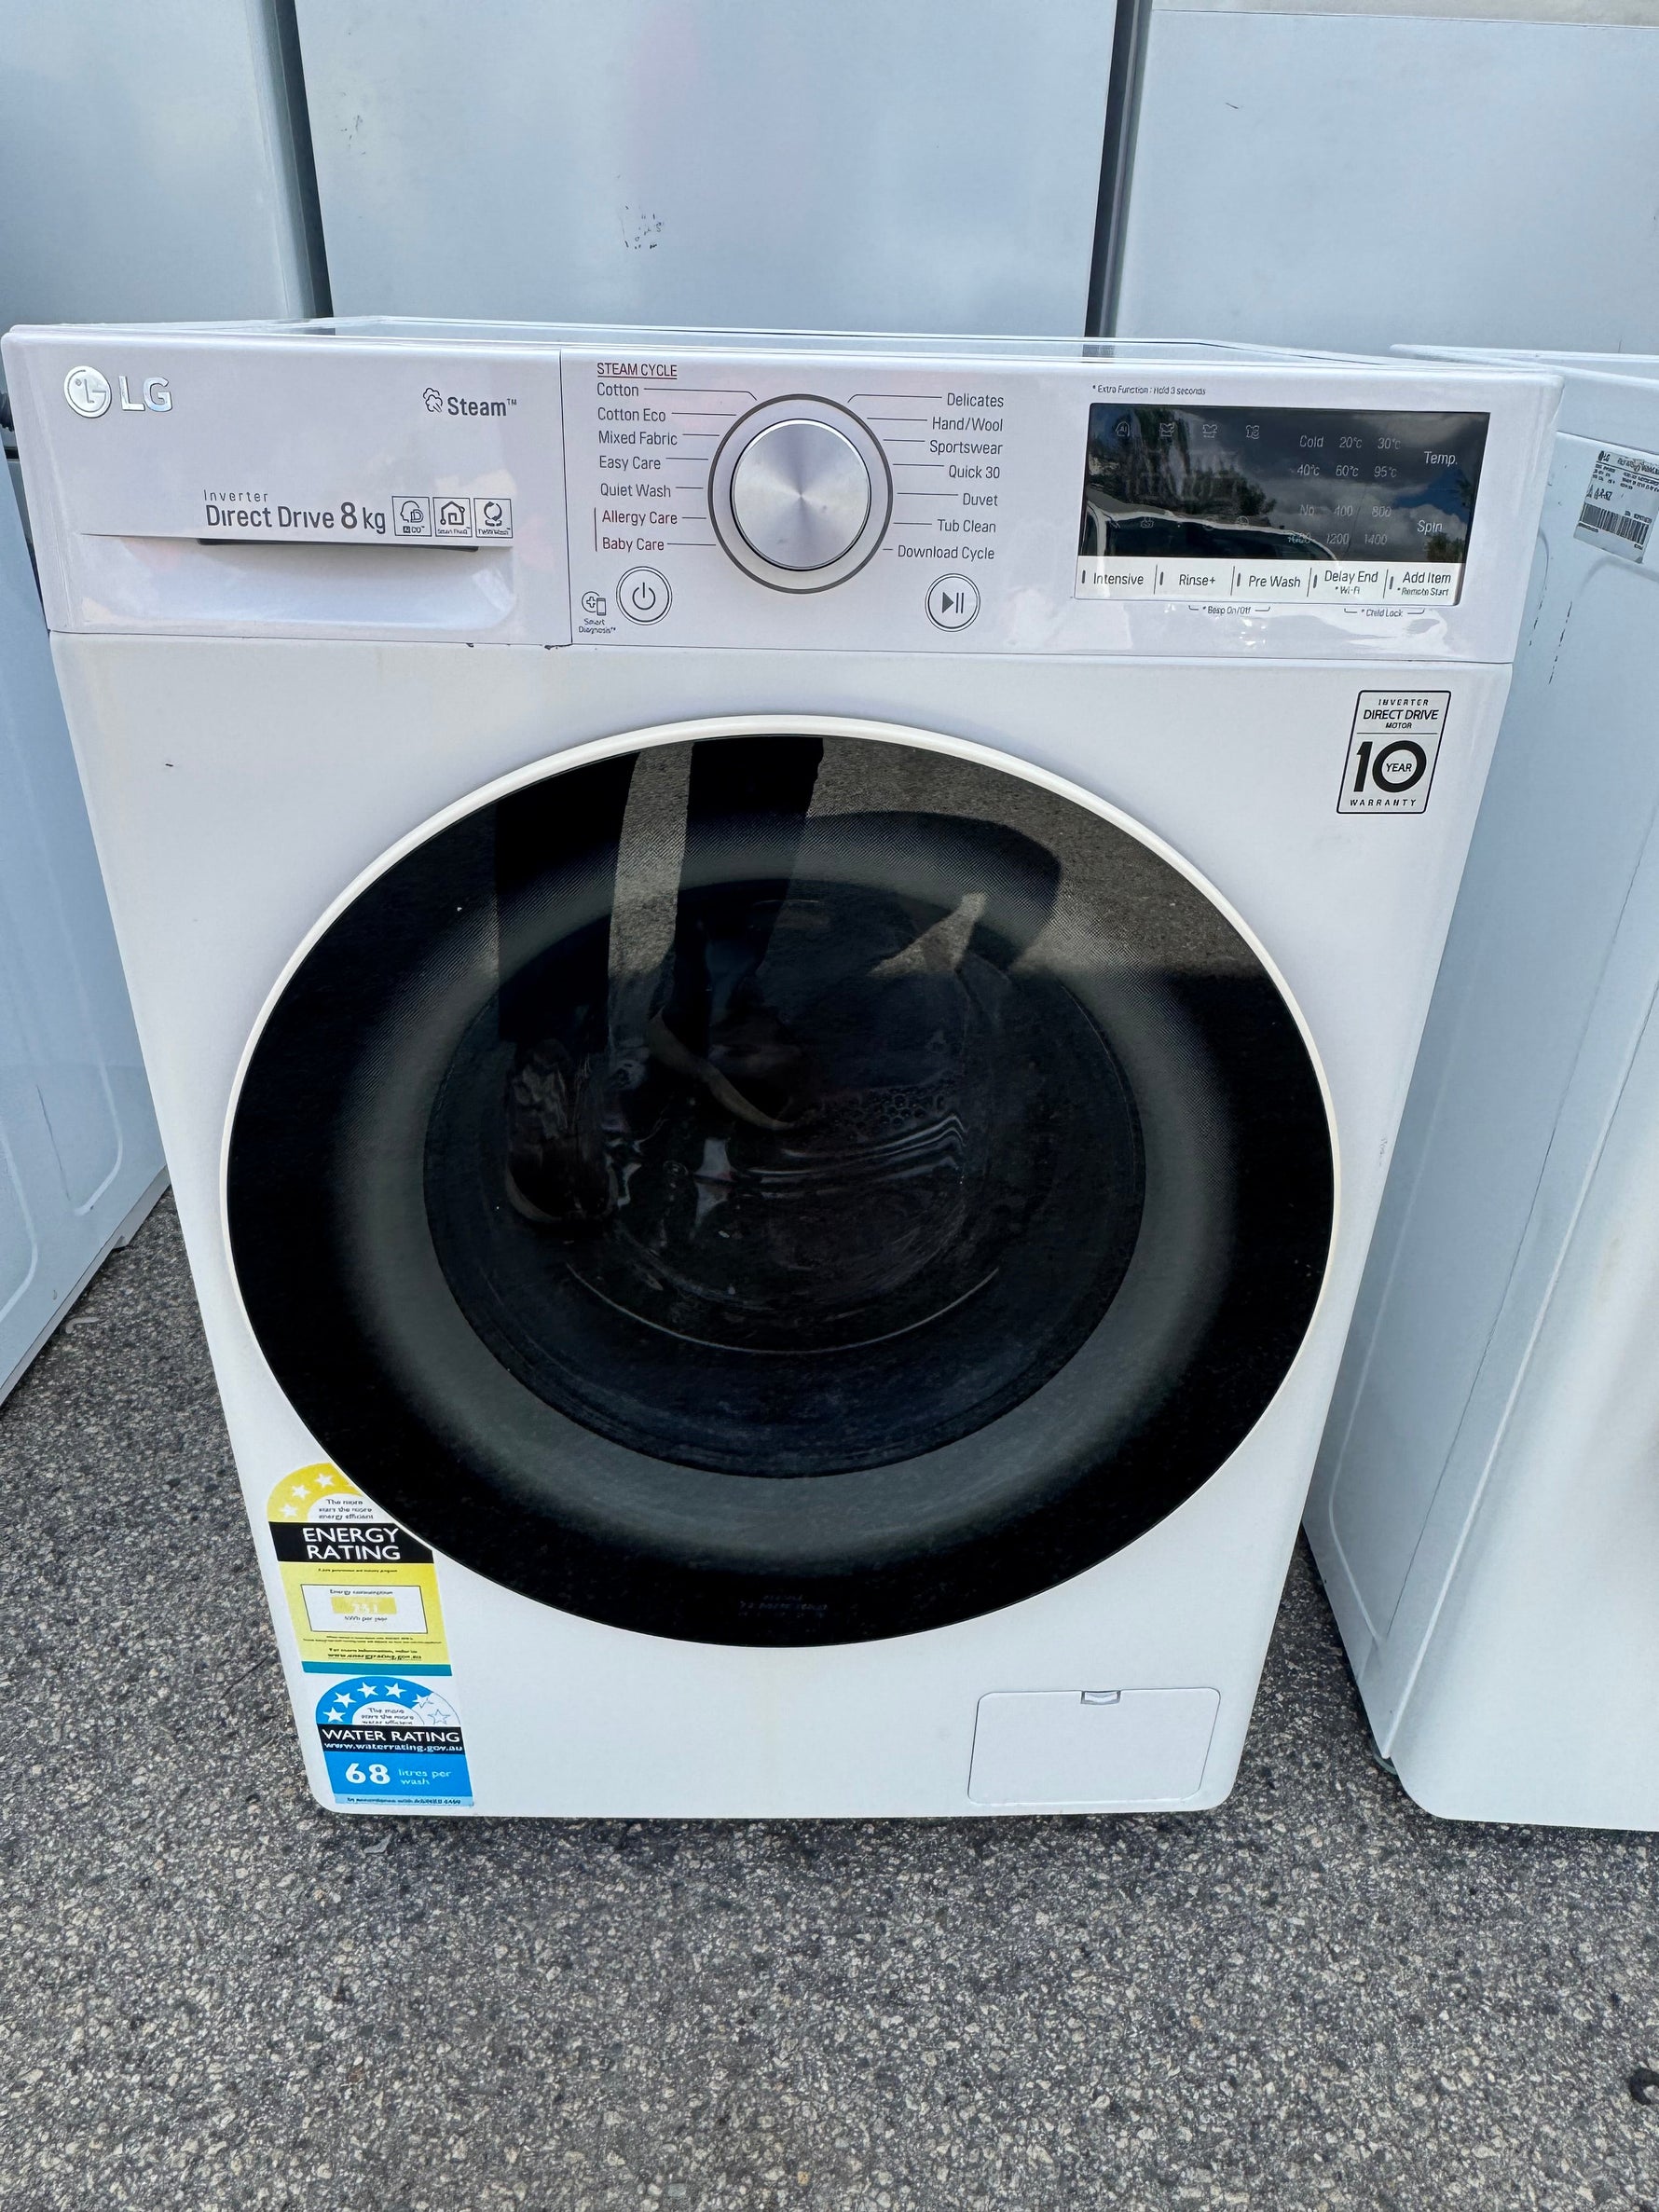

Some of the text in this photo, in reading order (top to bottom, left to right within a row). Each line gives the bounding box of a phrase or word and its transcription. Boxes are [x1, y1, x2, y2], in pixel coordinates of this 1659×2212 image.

[597, 362, 678, 378] STEAM CYCLE
[118, 375, 173, 413] LG
[596, 382, 639, 397] Cotton
[1098, 384, 1117, 393] Extra
[1117, 385, 1148, 394] Function
[1171, 387, 1175, 395] 3
[1176, 387, 1206, 395] seconds
[947, 392, 1005, 408] Delicates
[597, 407, 666, 422] Cotton Eco
[932, 417, 1004, 433] Hand/Wool
[598, 431, 678, 446] Mixed Fabric
[1299, 434, 1324, 447] Cold
[929, 440, 1004, 457] Sportswear
[599, 456, 661, 473] Easy Care
[1424, 451, 1458, 467] Temp.
[948, 465, 1001, 480] Quick 30
[203, 489, 268, 502] Inverter
[600, 483, 671, 499] Quiet Wash
[963, 492, 999, 507] Duvet
[205, 504, 273, 528] Direct
[277, 505, 335, 529] Drive
[1299, 504, 1392, 518] No 400 800
[602, 510, 678, 528] Allergy Care
[938, 519, 996, 534] Tub Clean
[1417, 519, 1443, 536] Spin
[602, 537, 665, 554] Baby Care
[1326, 533, 1350, 545] 1200
[1364, 533, 1388, 545] 1400
[898, 544, 994, 563] Download Cycle
[1093, 572, 1144, 585] Intensive
[1178, 574, 1215, 586] Rinse+
[1248, 574, 1301, 588] Pre Wash
[1324, 570, 1378, 584] Delay End
[1402, 571, 1451, 584] Add Item
[1430, 587, 1448, 596] Start
[1385, 609, 1403, 617] Lock
[1378, 698, 1429, 707] INVERTER
[1363, 709, 1439, 721] DIRECT DRIVE
[1353, 740, 1427, 793] 10
[1386, 763, 1412, 773] YEAR
[302, 1527, 399, 1544] ENERGY
[307, 1545, 401, 1560] RATING
[322, 1728, 460, 1742] WATER RATING
[324, 1742, 463, 1752] www.waterrating.gov.au
[345, 1762, 391, 1785] 68
[399, 1768, 452, 1779] litres per
